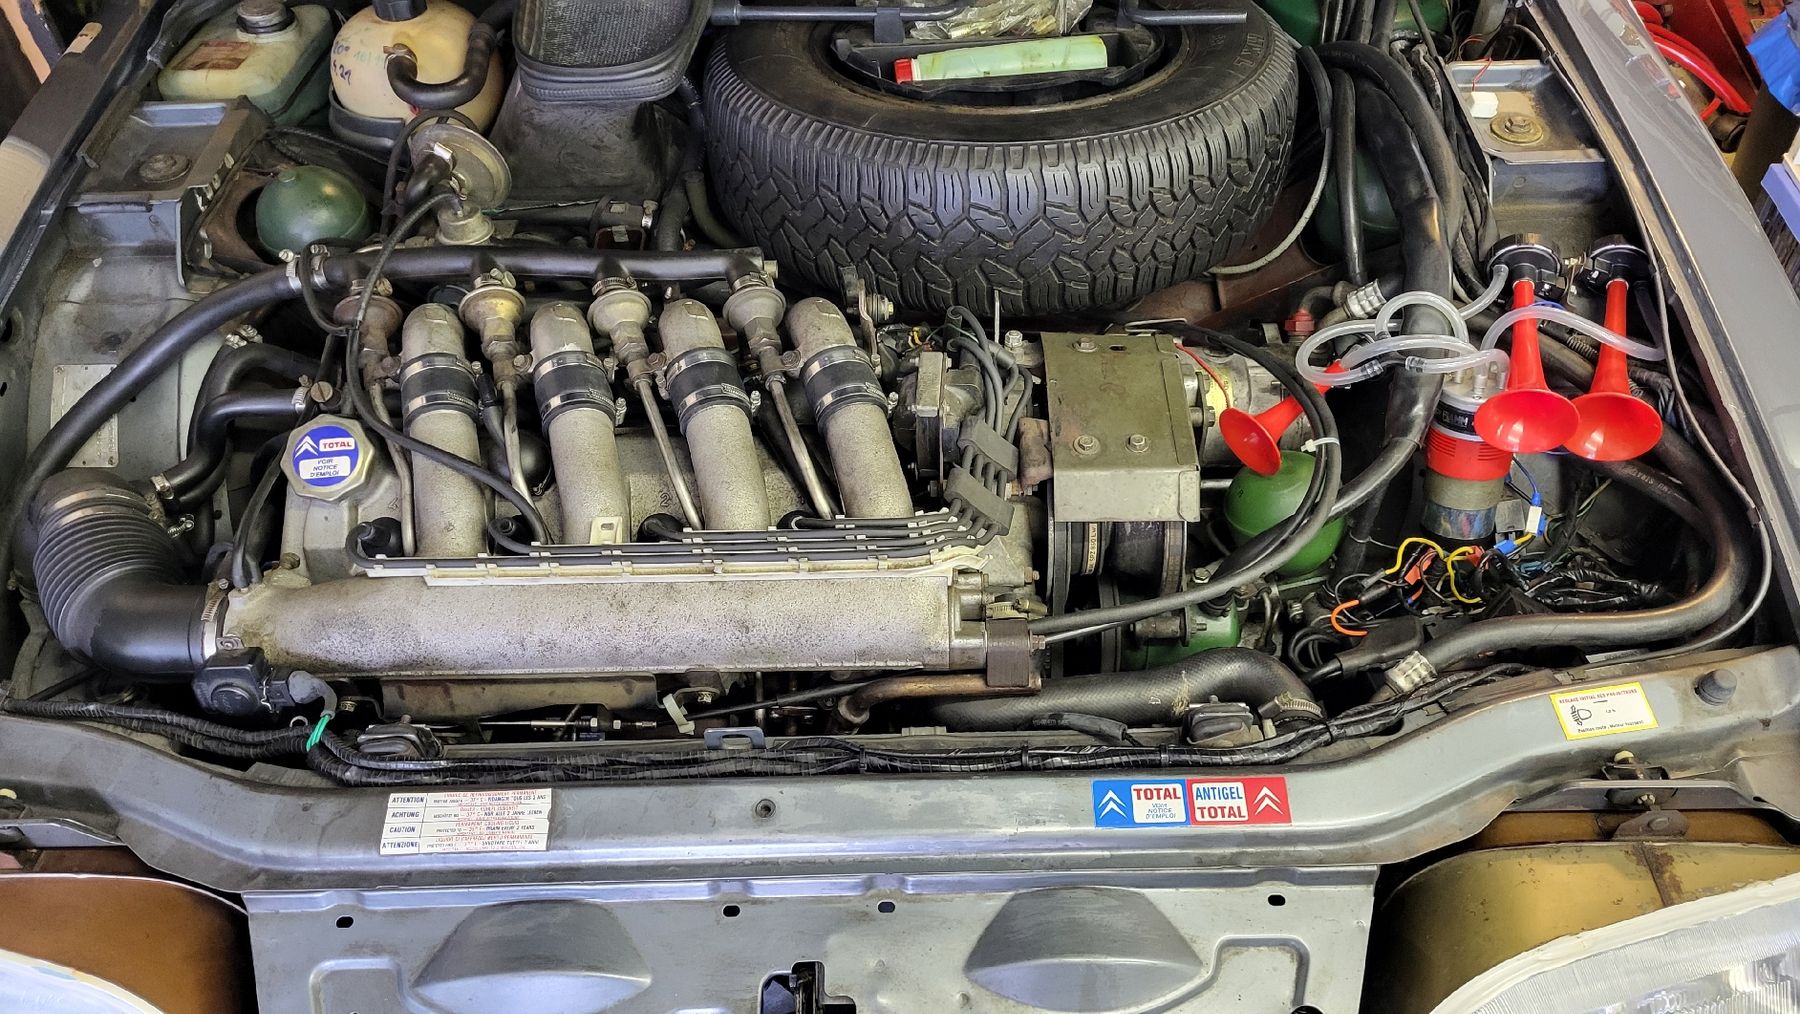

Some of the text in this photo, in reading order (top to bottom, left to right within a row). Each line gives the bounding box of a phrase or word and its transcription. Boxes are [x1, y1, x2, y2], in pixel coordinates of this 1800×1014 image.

[323, 441, 352, 449] TOTAL
[1133, 787, 1181, 801] TOTAL
[1195, 786, 1243, 801] ANTIGEL
[391, 796, 425, 804] ATTENTION
[1197, 805, 1246, 819] TOTAL
[382, 841, 418, 849] ATTENZIONE
